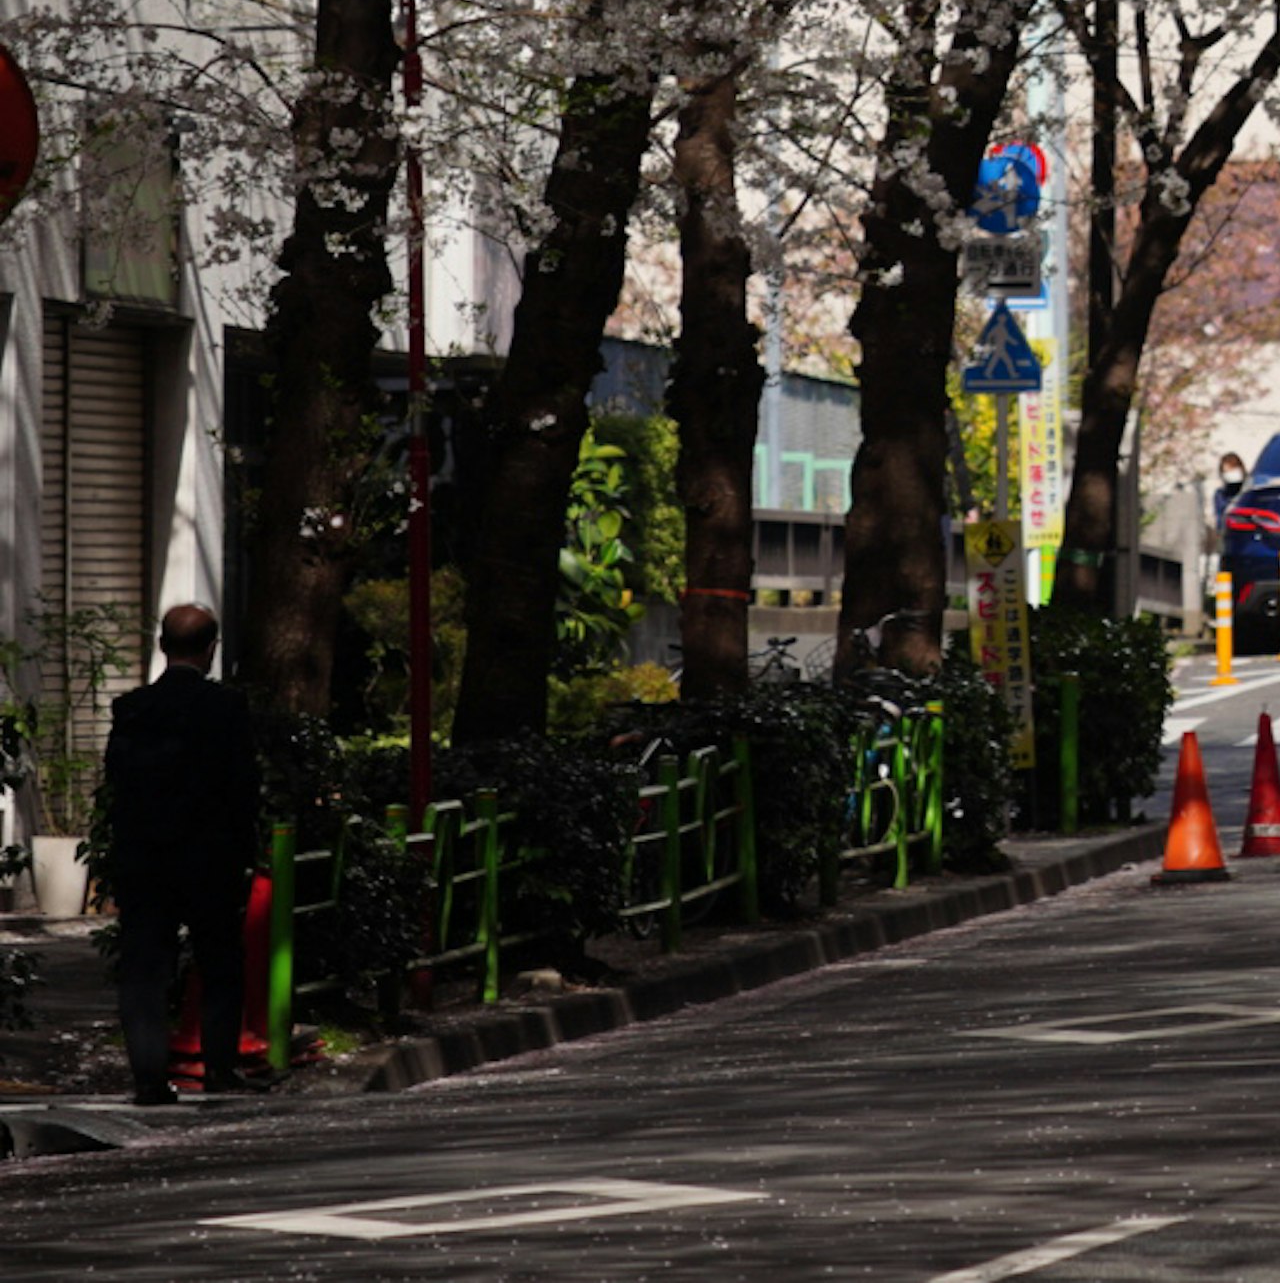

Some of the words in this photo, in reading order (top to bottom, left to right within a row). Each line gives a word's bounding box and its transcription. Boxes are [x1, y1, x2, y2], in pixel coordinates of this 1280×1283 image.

[1026, 391, 1045, 528] ピード落とせ
